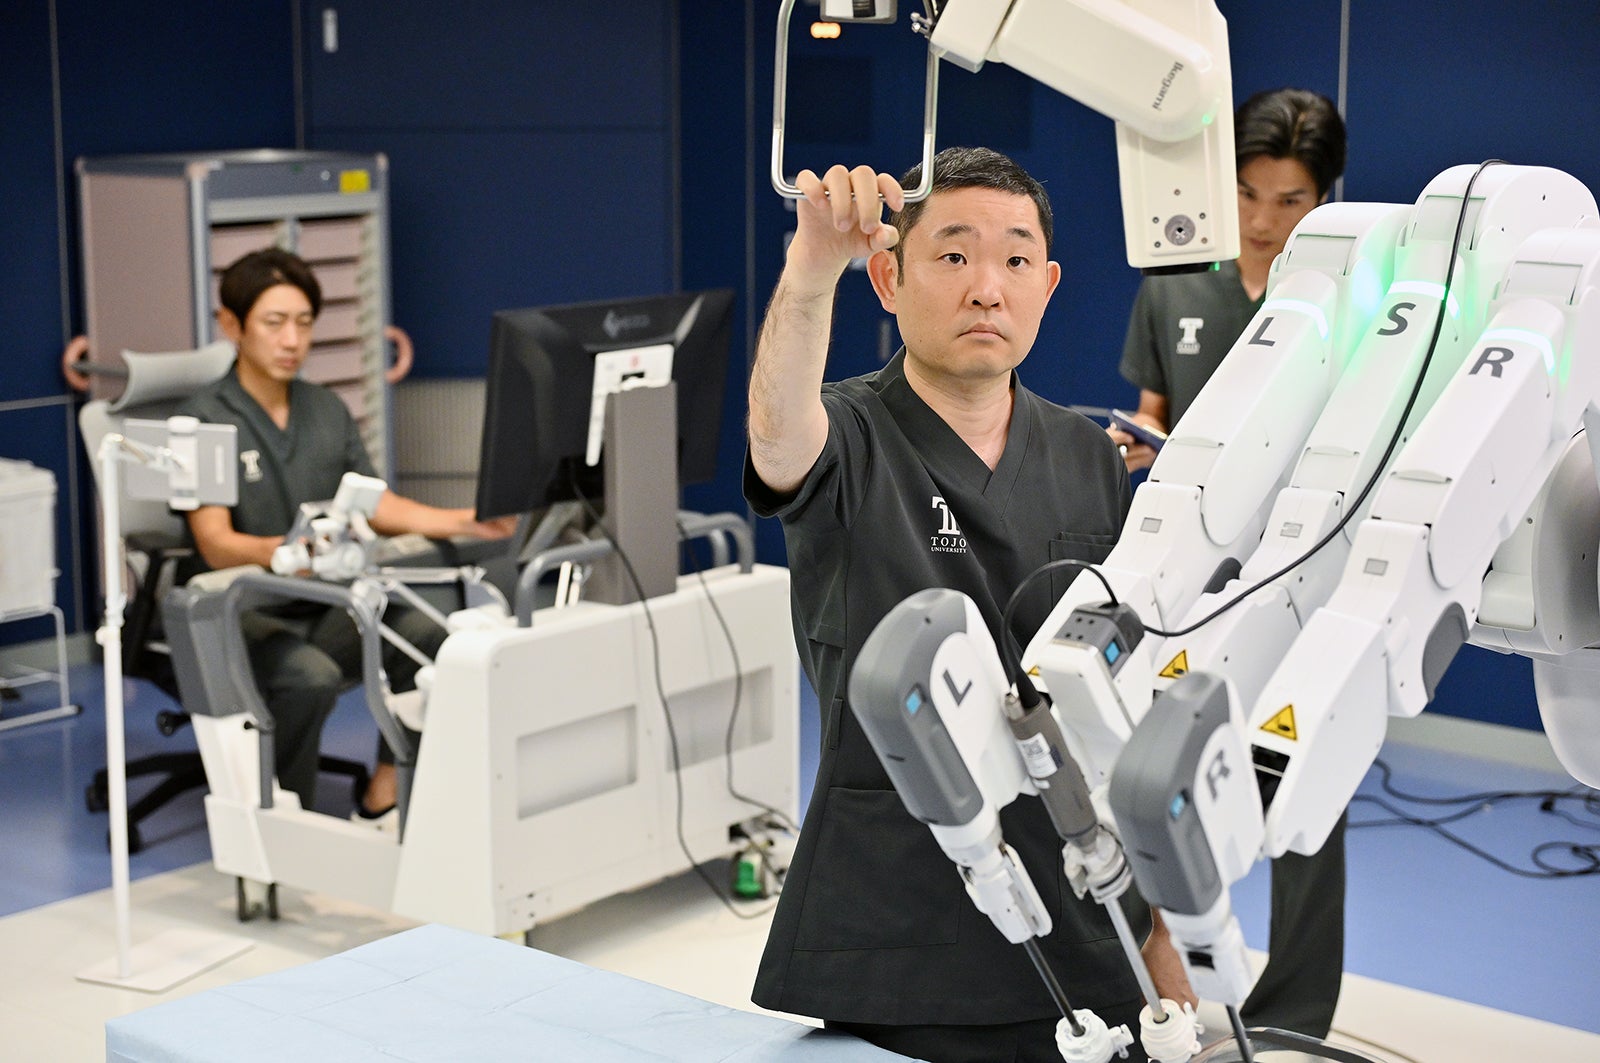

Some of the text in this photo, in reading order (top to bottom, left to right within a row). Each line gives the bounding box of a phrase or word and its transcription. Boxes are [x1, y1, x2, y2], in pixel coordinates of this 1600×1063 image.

[1247, 316, 1276, 347] L
[1376, 302, 1417, 336] S
[1468, 346, 1514, 379] R
[930, 536, 967, 548] TOJO
[930, 546, 967, 554] UNIVERSITY
[942, 669, 973, 706] L
[1206, 749, 1230, 802] R
